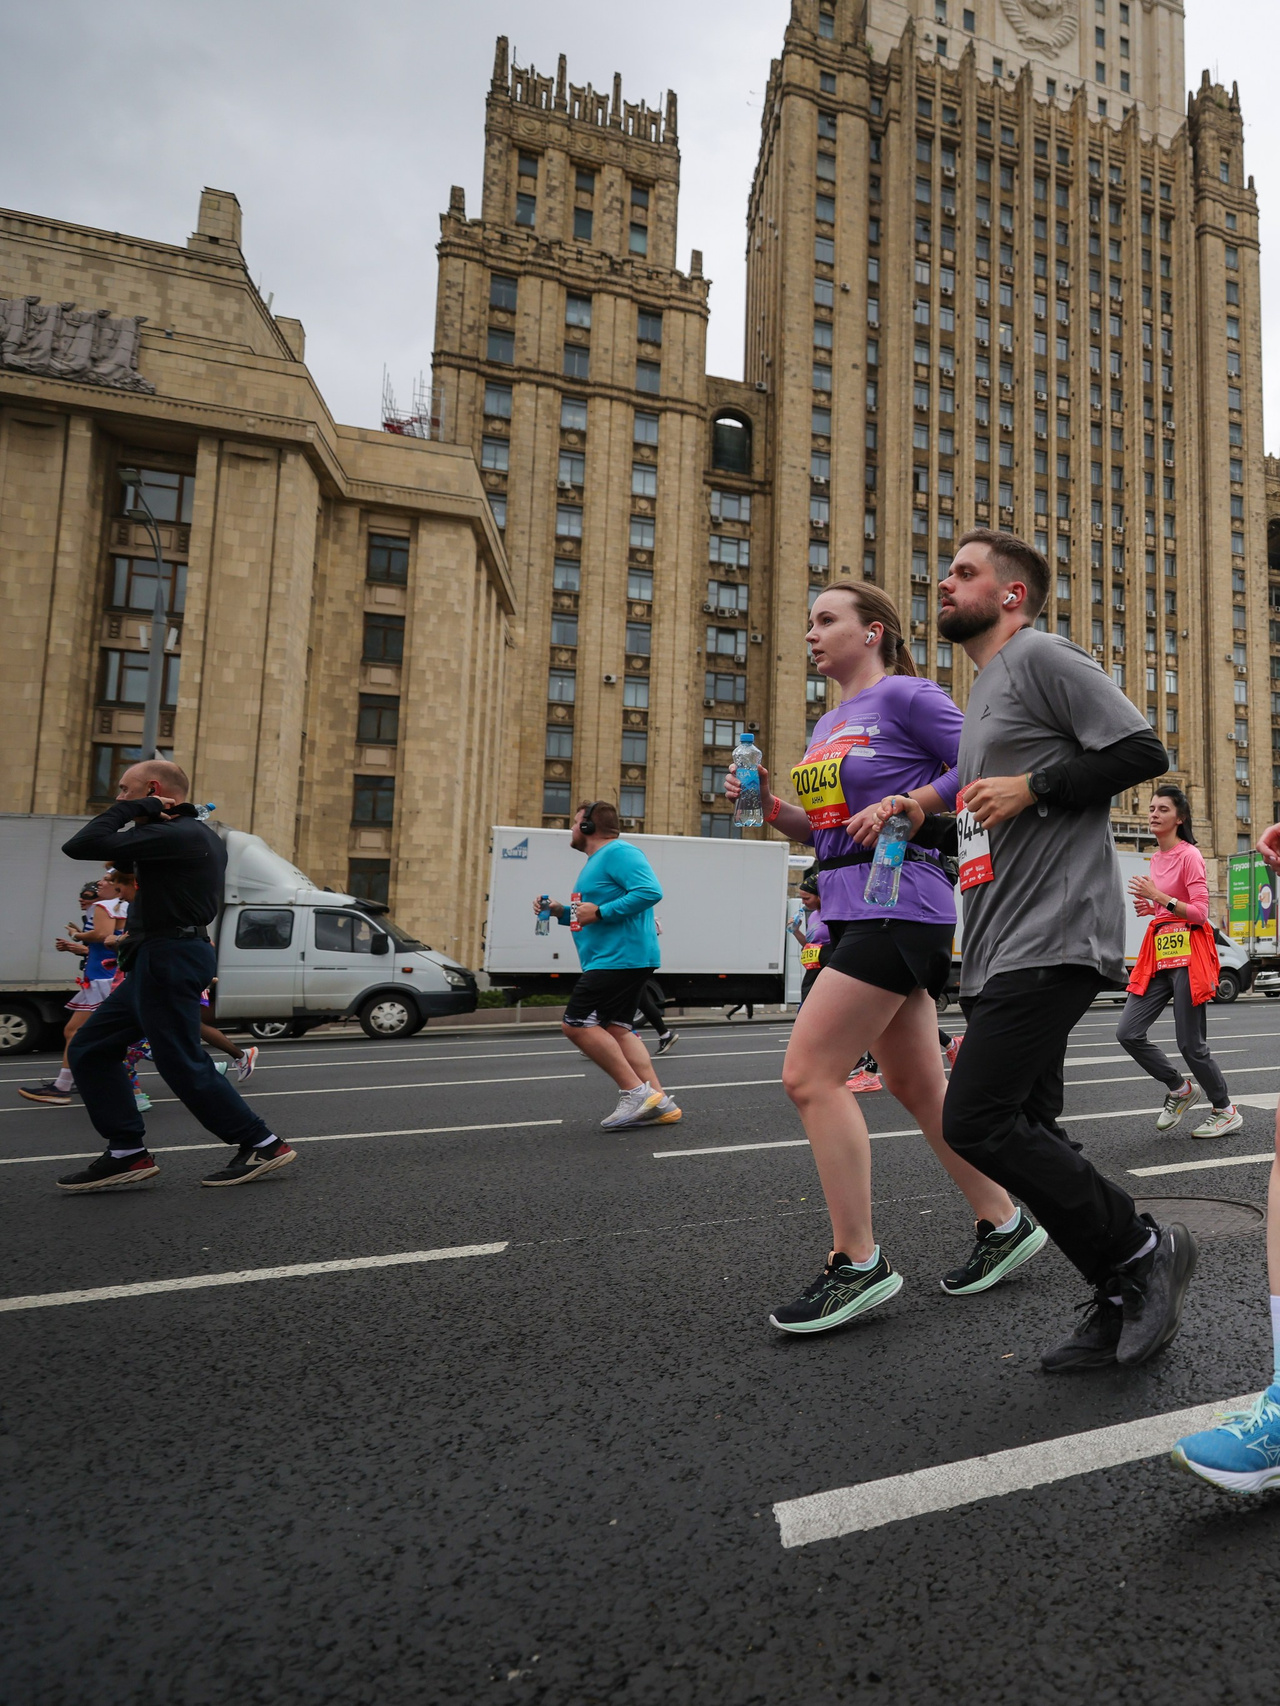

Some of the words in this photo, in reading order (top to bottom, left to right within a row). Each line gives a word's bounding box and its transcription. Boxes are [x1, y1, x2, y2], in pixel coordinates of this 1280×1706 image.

[792, 762, 838, 796] 20243
[811, 795, 825, 805] АННА
[957, 812, 986, 848] 944
[1157, 934, 1184, 951] 8259
